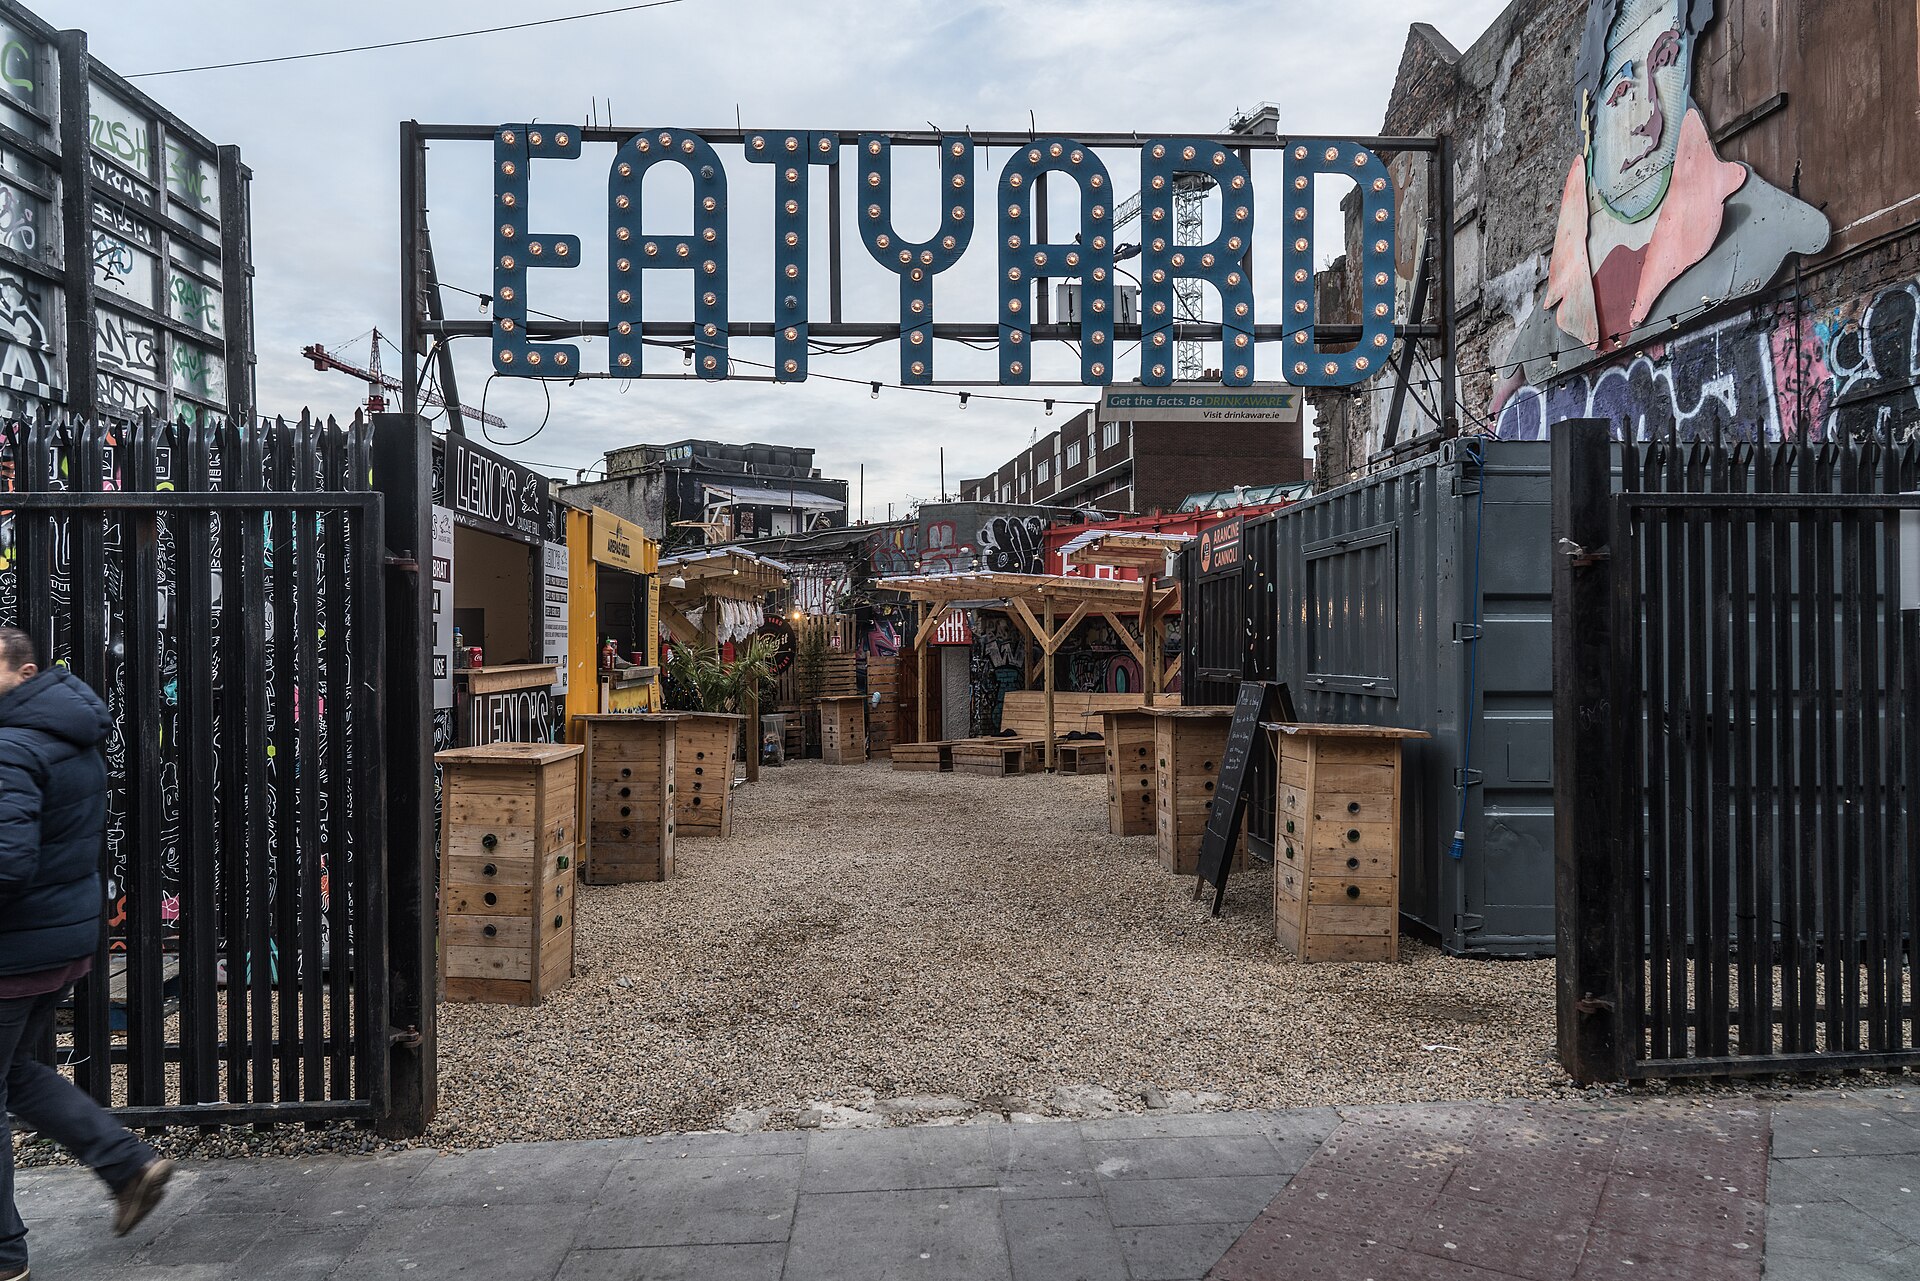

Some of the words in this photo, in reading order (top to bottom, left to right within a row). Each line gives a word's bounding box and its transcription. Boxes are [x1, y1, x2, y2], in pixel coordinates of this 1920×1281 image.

[493, 122, 1396, 387] EATYARD
[1110, 396, 1131, 407] Get
[1134, 395, 1153, 406] the
[1156, 395, 1186, 407] facts.
[1189, 396, 1203, 407] Be
[1204, 395, 1283, 407] DRINKAWARE
[1203, 410, 1222, 419] Visit
[1224, 410, 1280, 419] drinkaware.ie
[456, 445, 517, 527] LENO'S
[1214, 546, 1238, 568] CANNOLI
